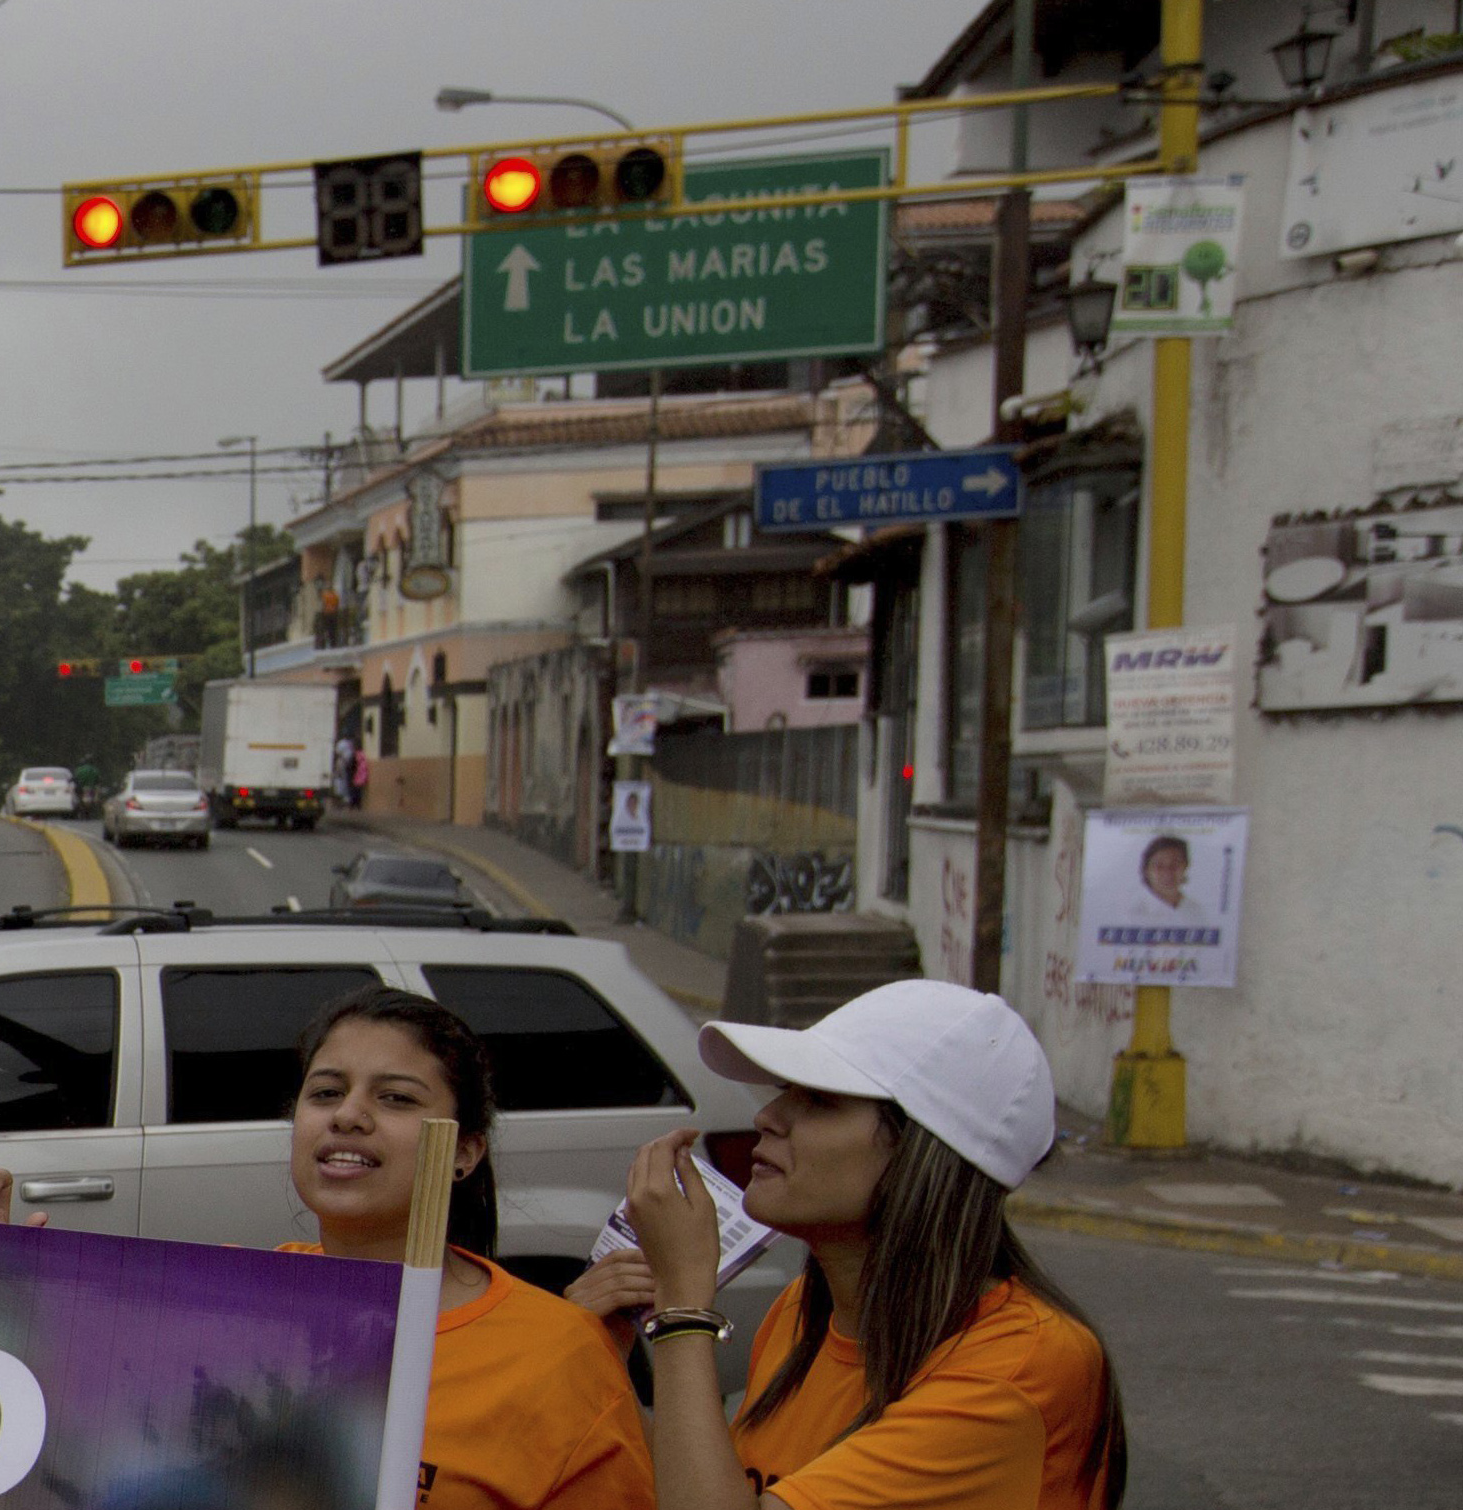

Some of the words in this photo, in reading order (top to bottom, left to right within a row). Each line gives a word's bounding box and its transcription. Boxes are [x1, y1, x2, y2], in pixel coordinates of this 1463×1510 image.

[565, 253, 645, 292] LAS
[668, 238, 828, 283] MARIAS
[563, 308, 619, 344] LA
[643, 297, 767, 338] UNION
[814, 463, 912, 493] PUEBLO
[772, 497, 802, 523] DE
[816, 494, 843, 519] EL
[858, 486, 956, 515] HATILLO
[1112, 644, 1228, 672] MRW
